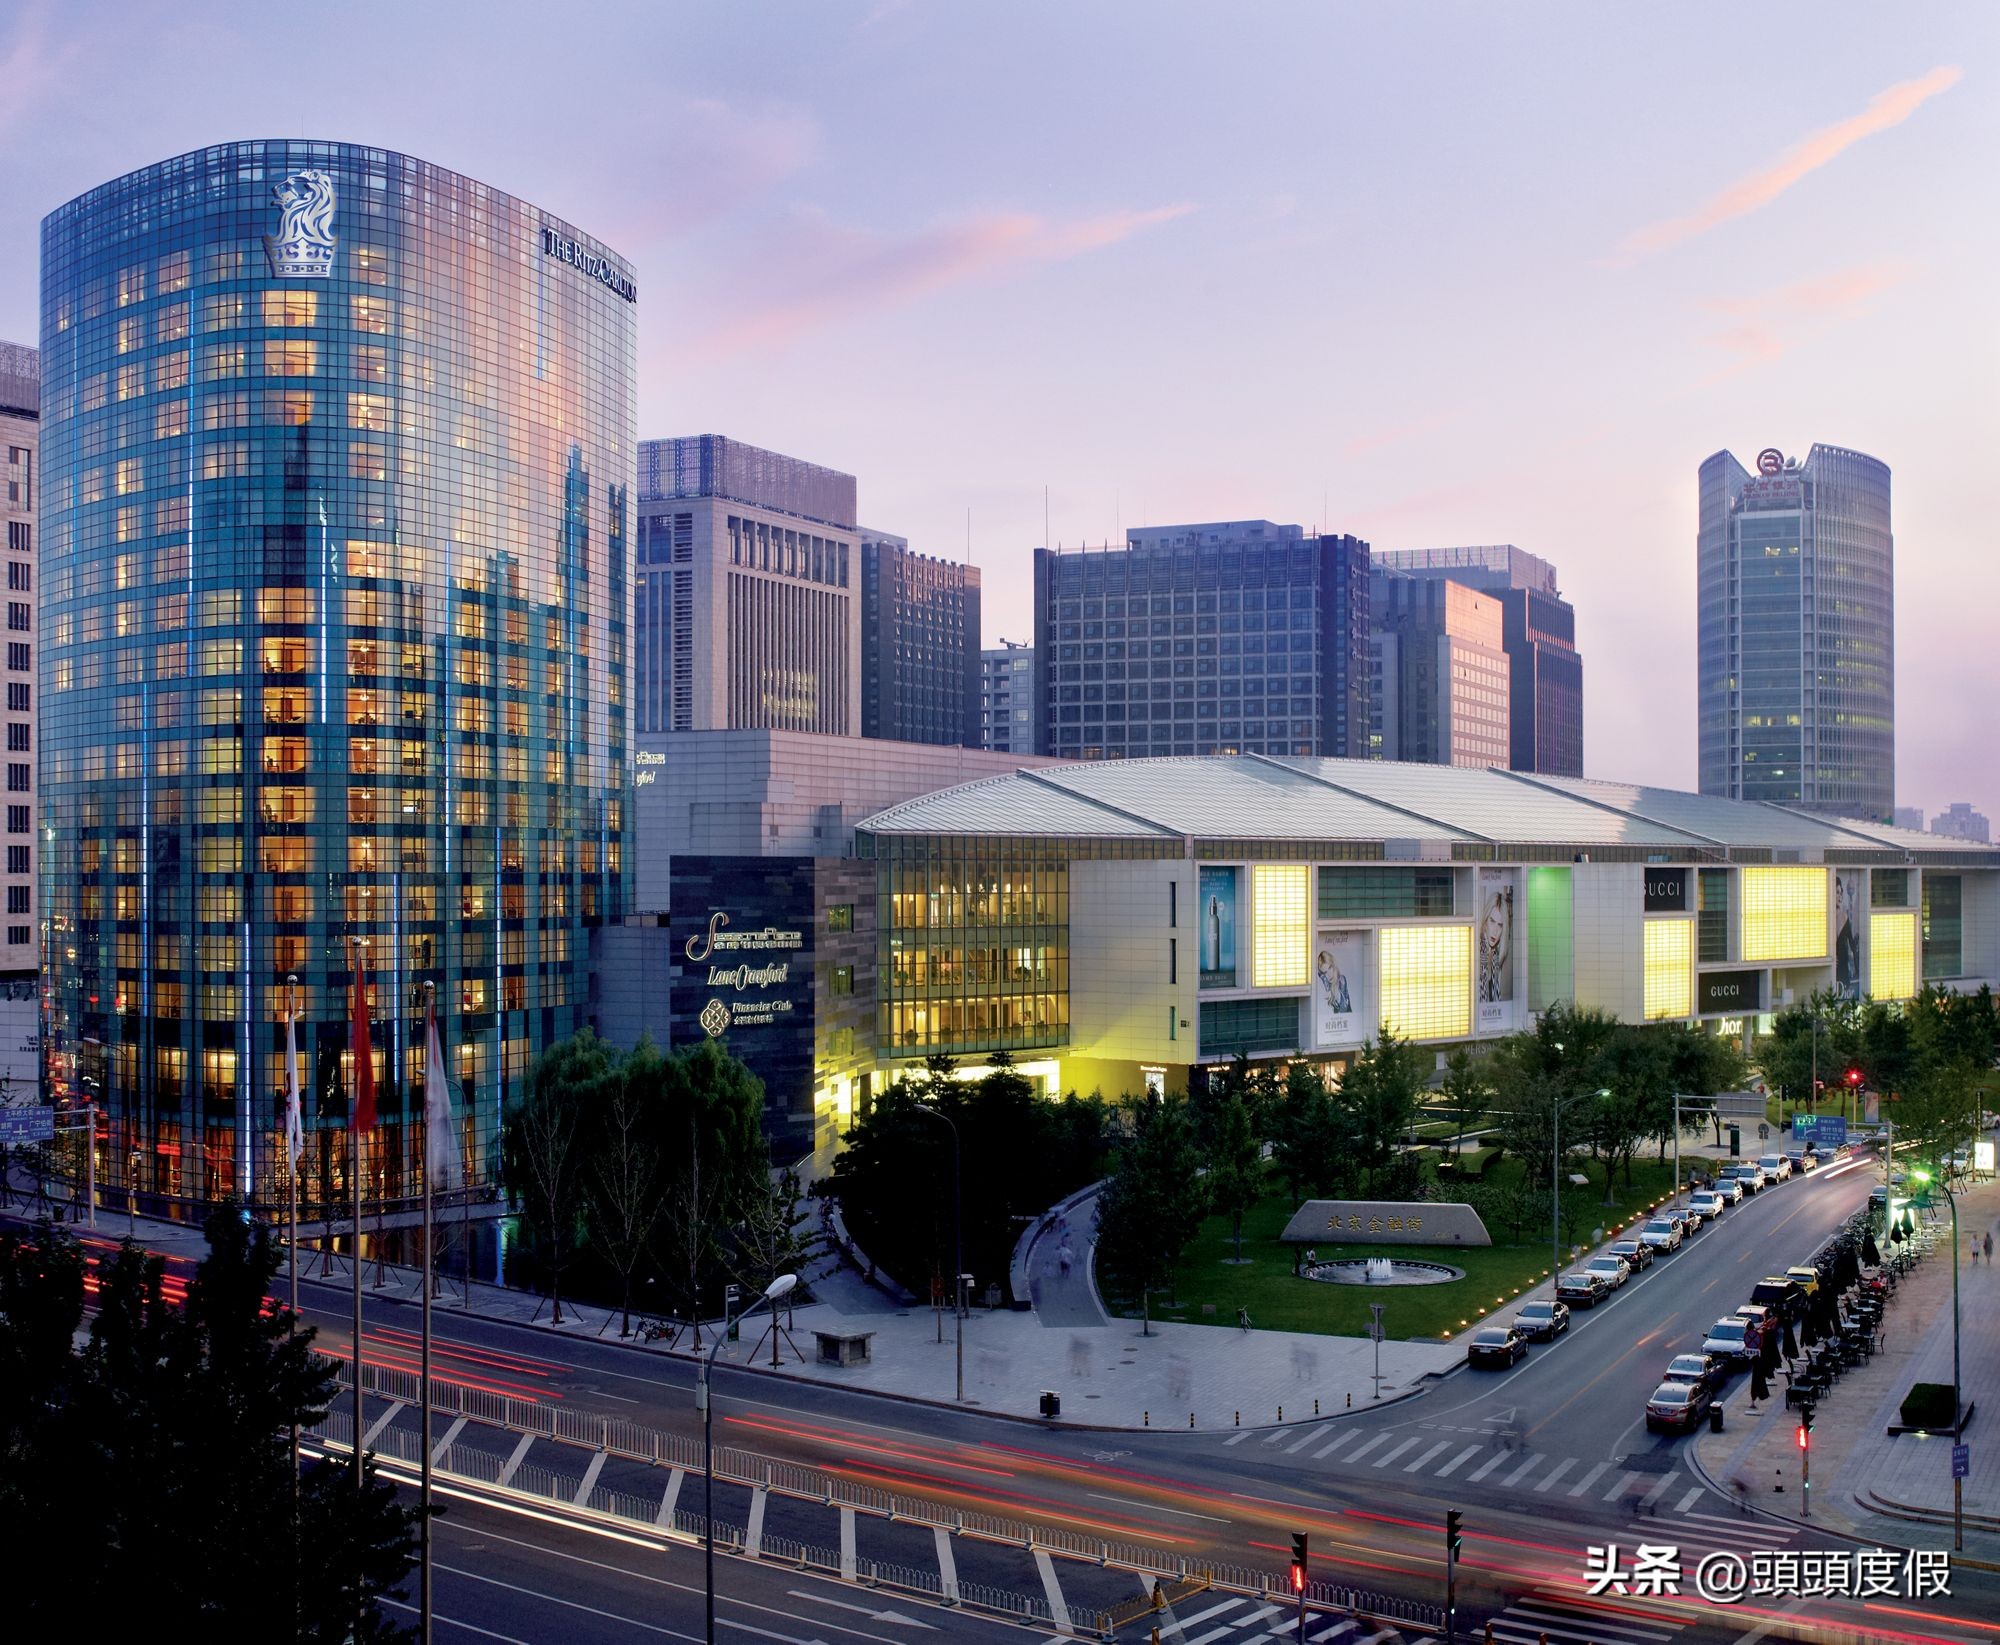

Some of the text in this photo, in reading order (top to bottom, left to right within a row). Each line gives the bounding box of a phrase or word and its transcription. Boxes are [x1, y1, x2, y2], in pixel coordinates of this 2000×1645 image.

[545, 228, 572, 263] THE
[707, 965, 736, 985] Lane
[1711, 984, 1740, 997] GUCCI
[1328, 1214, 1423, 1232] 北京金融街
